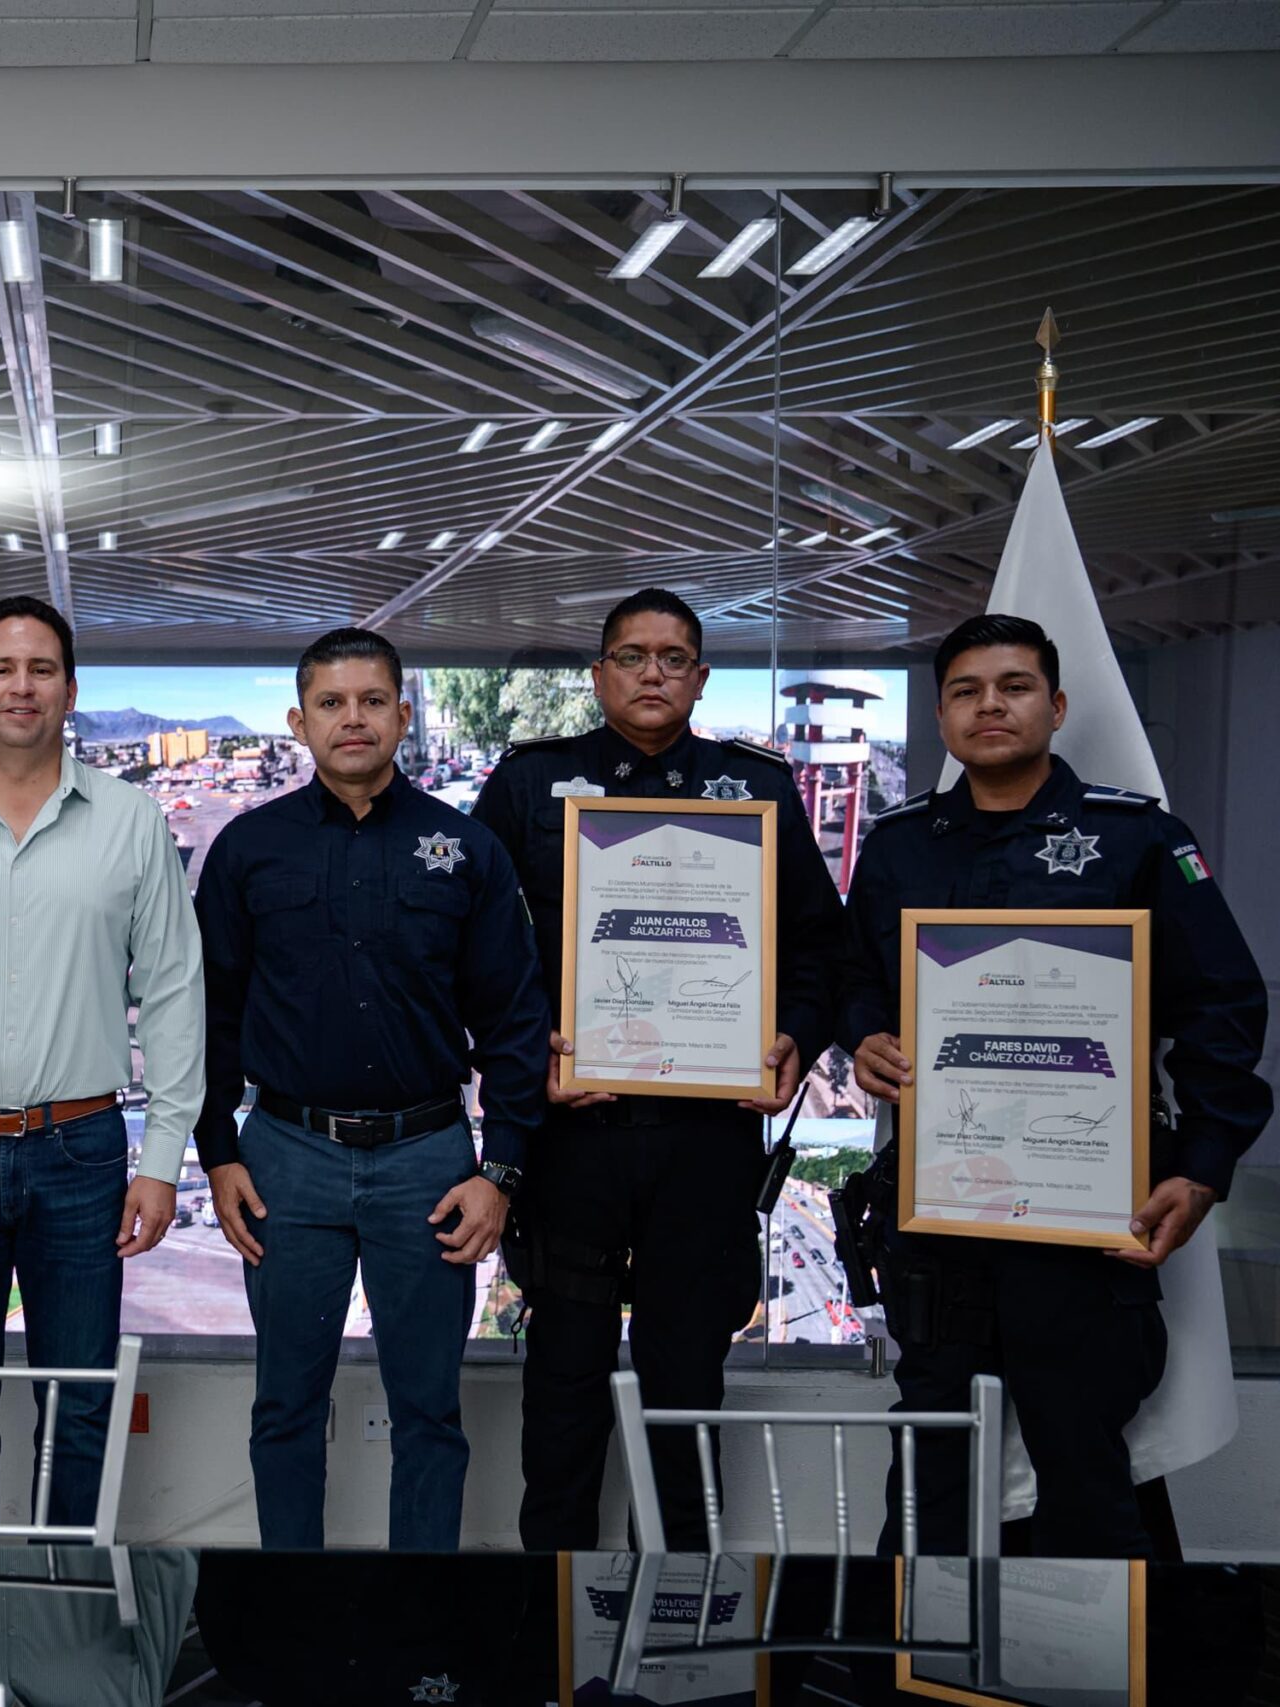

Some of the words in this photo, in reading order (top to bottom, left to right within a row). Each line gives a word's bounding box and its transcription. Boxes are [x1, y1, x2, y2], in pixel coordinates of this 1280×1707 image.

[634, 916, 662, 926] JUAN
[664, 917, 707, 928] CARLOS
[630, 926, 673, 936] SALAZAR
[675, 928, 711, 938] FLORES
[985, 1042, 1021, 1051] FARES
[1024, 1042, 1060, 1053] DAVID
[970, 1050, 1013, 1062] CHÁVEZ
[1014, 1052, 1073, 1065] GONZÁLEZ
[1023, 1137, 1047, 1145] Miguel
[1048, 1137, 1069, 1147] Ángel
